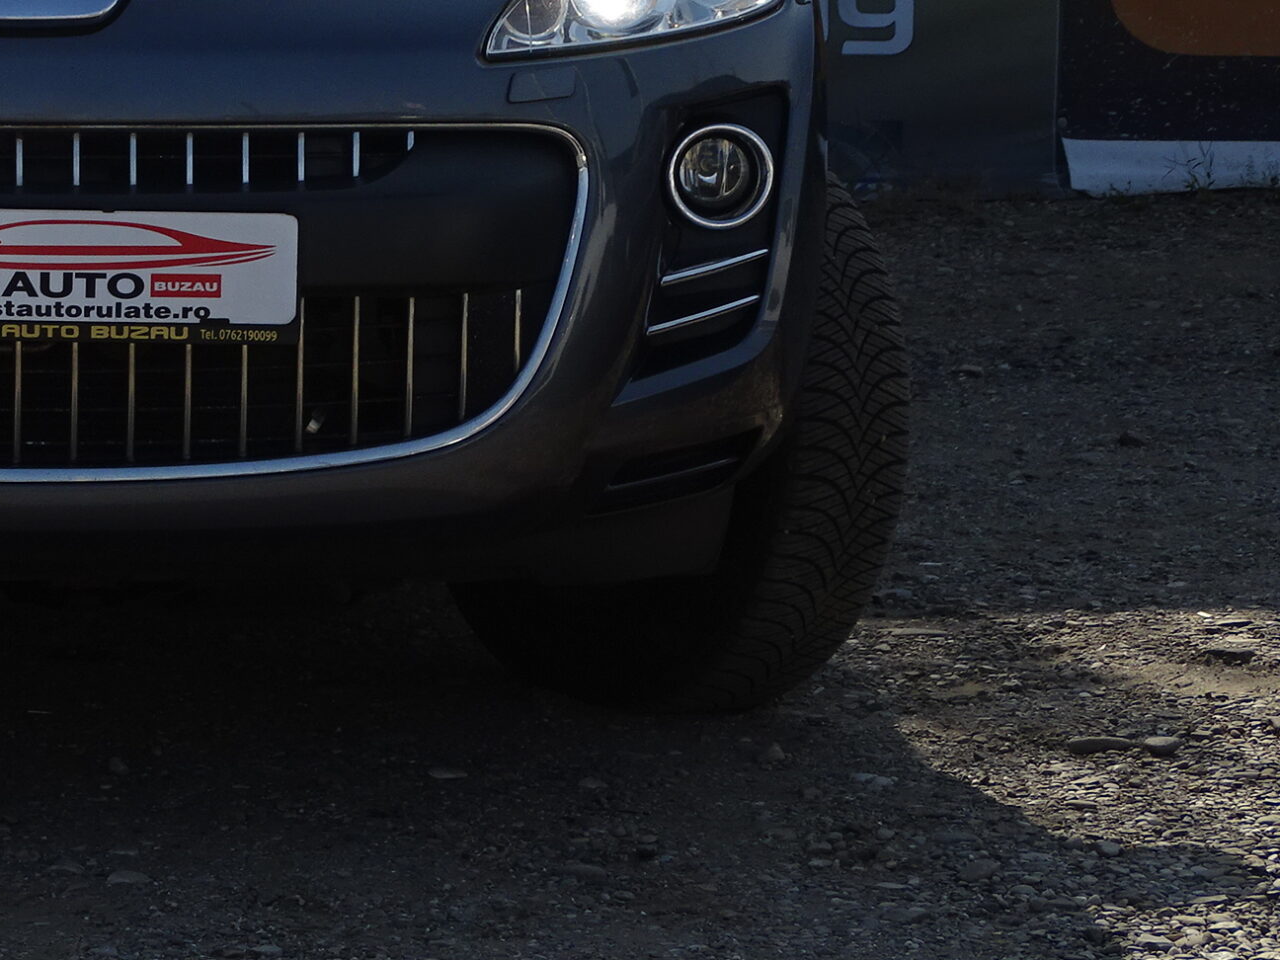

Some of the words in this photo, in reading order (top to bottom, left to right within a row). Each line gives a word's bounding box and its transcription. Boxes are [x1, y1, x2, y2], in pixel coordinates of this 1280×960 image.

[1, 271, 145, 300] AUTO
[154, 280, 218, 293] BUZAU
[1, 322, 80, 339] AUTO
[90, 325, 189, 340] BUZAU
